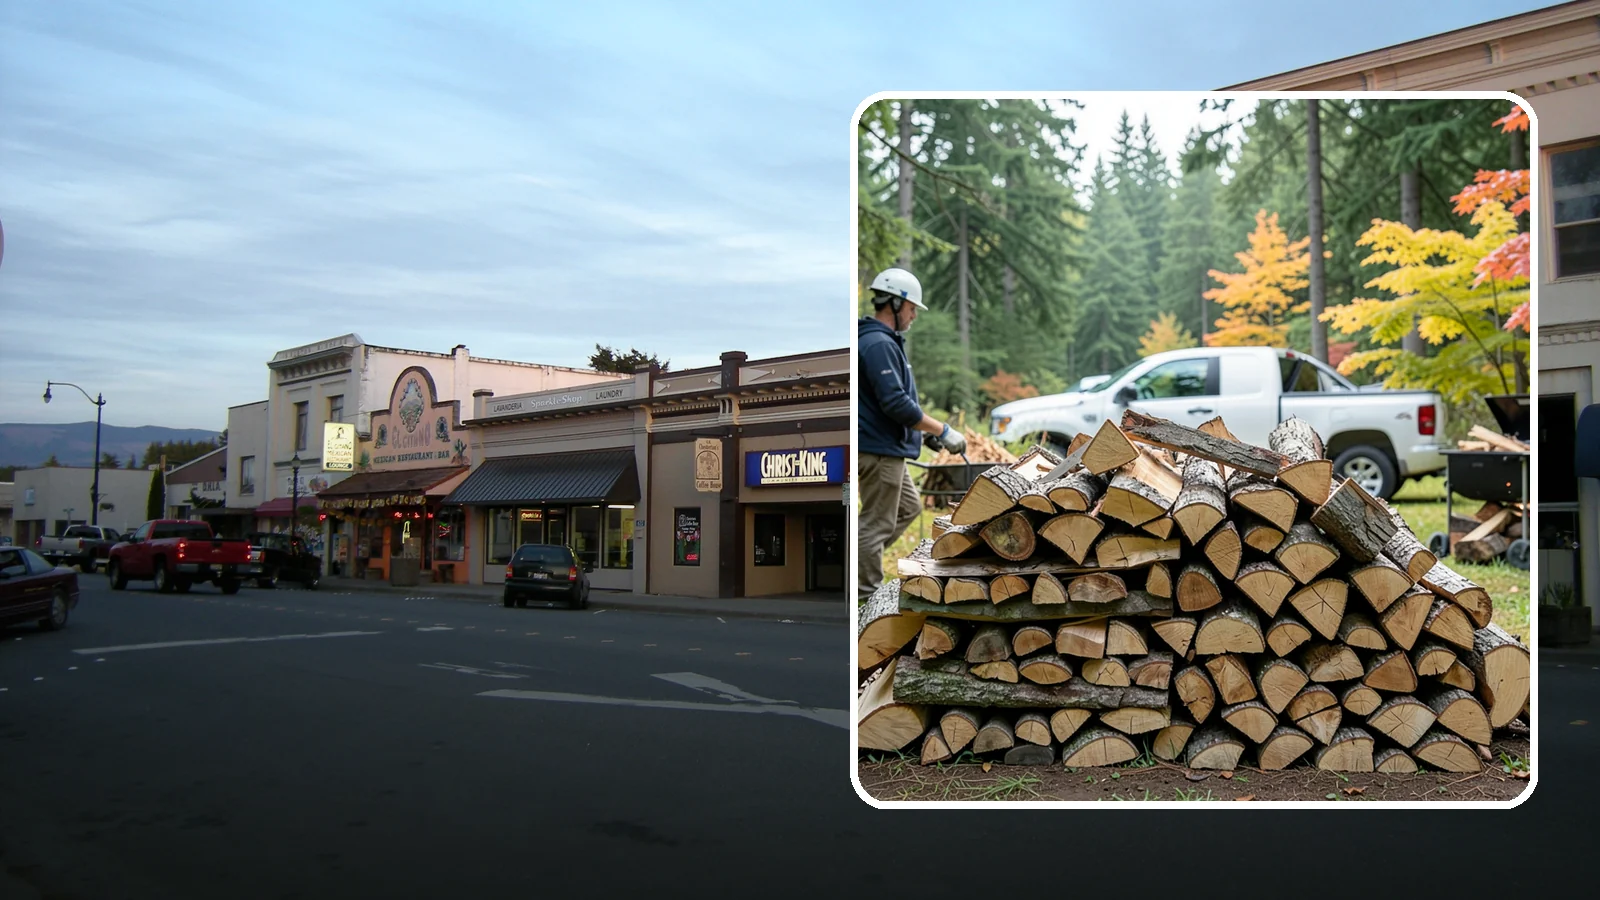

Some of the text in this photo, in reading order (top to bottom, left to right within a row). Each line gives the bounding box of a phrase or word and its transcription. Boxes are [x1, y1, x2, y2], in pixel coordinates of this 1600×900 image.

[493, 402, 522, 412] LAVANDERIA
[562, 394, 582, 405] Shop
[595, 388, 623, 400] LAUNDRY
[398, 451, 433, 462] RESTAURANT
[438, 450, 450, 459] BAR
